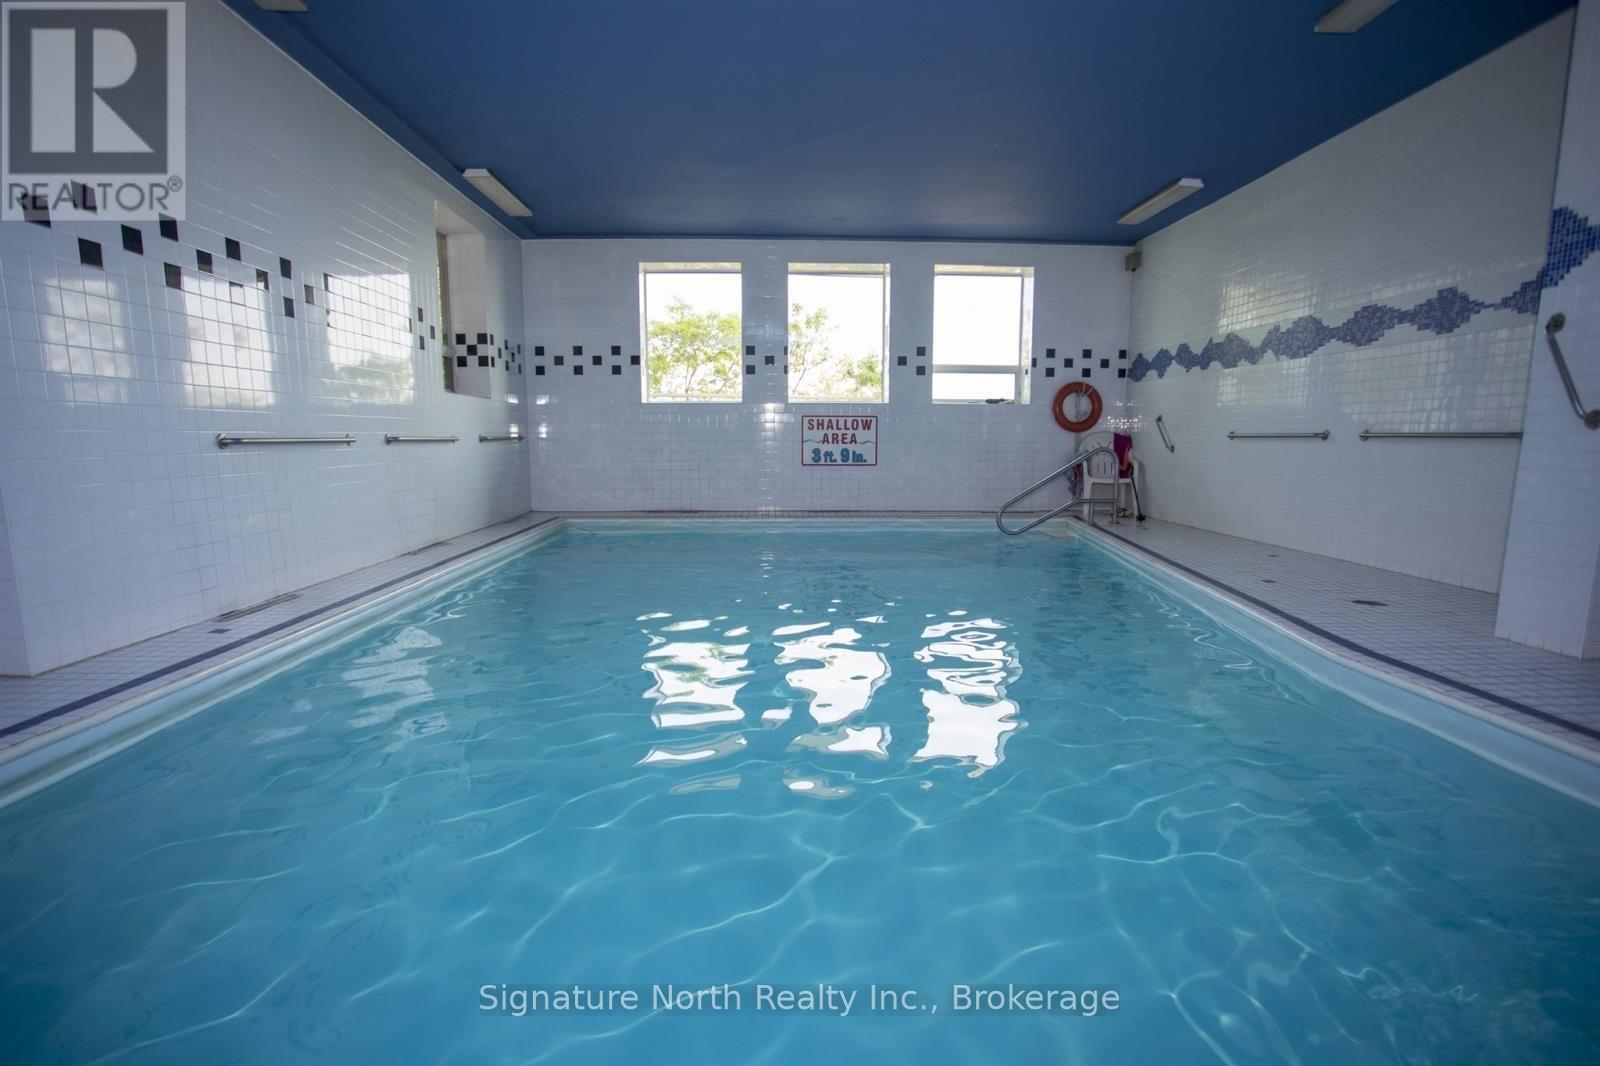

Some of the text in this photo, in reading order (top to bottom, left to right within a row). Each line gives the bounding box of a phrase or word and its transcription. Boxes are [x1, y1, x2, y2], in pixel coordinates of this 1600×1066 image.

[807, 418, 873, 431] SHALLOW
[822, 433, 858, 445] AREA
[811, 447, 822, 463] 3
[823, 450, 838, 463] ft.
[840, 447, 850, 463] 9
